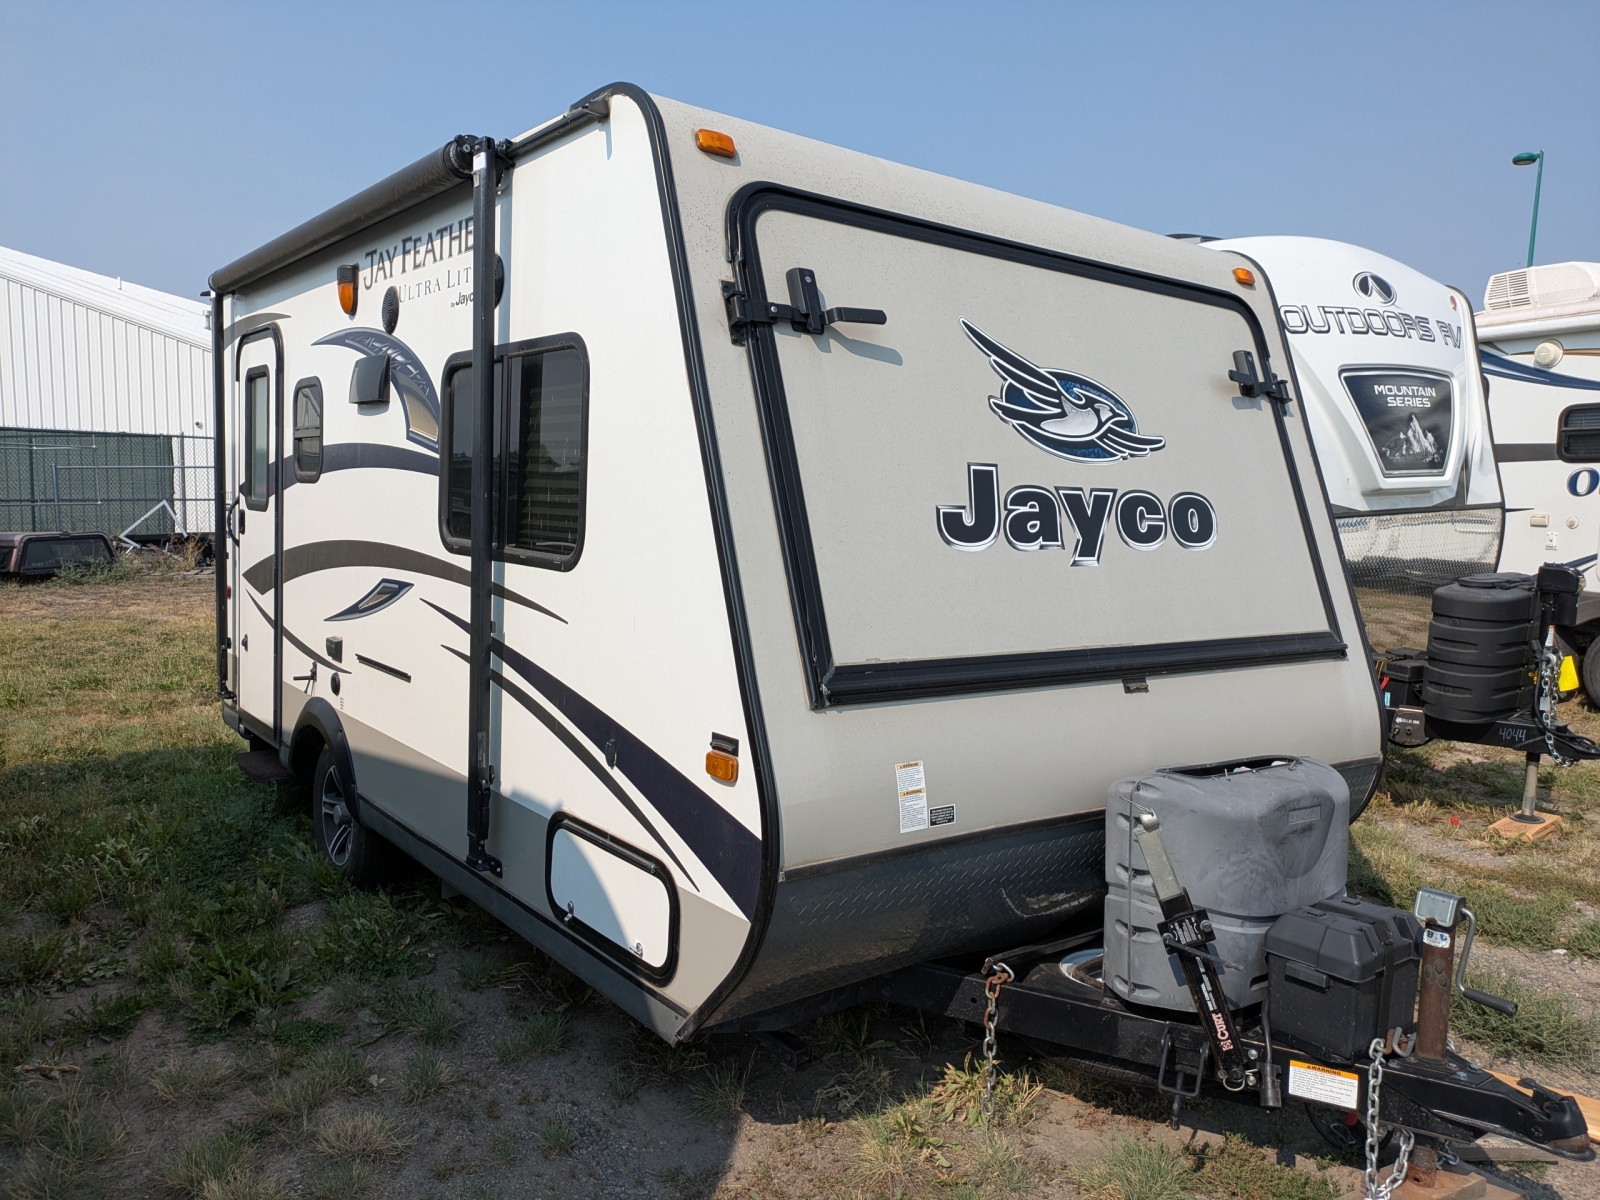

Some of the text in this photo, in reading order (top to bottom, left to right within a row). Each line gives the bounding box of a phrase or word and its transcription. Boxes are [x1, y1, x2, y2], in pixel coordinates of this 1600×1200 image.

[363, 215, 473, 291] JAY FEATHE
[399, 266, 472, 303] ULTRA LIT
[455, 291, 474, 307] Jayc
[1279, 304, 1462, 349] OUTDOORS RV
[1374, 384, 1437, 397] MOUNTAIN
[1387, 396, 1431, 408] SERIES
[1566, 467, 1600, 497] O
[935, 461, 1219, 567] Jayco
[1498, 728, 1527, 742] 4044
[1211, 1013, 1229, 1040] CURT
[1310, 1065, 1342, 1076] WARNING
